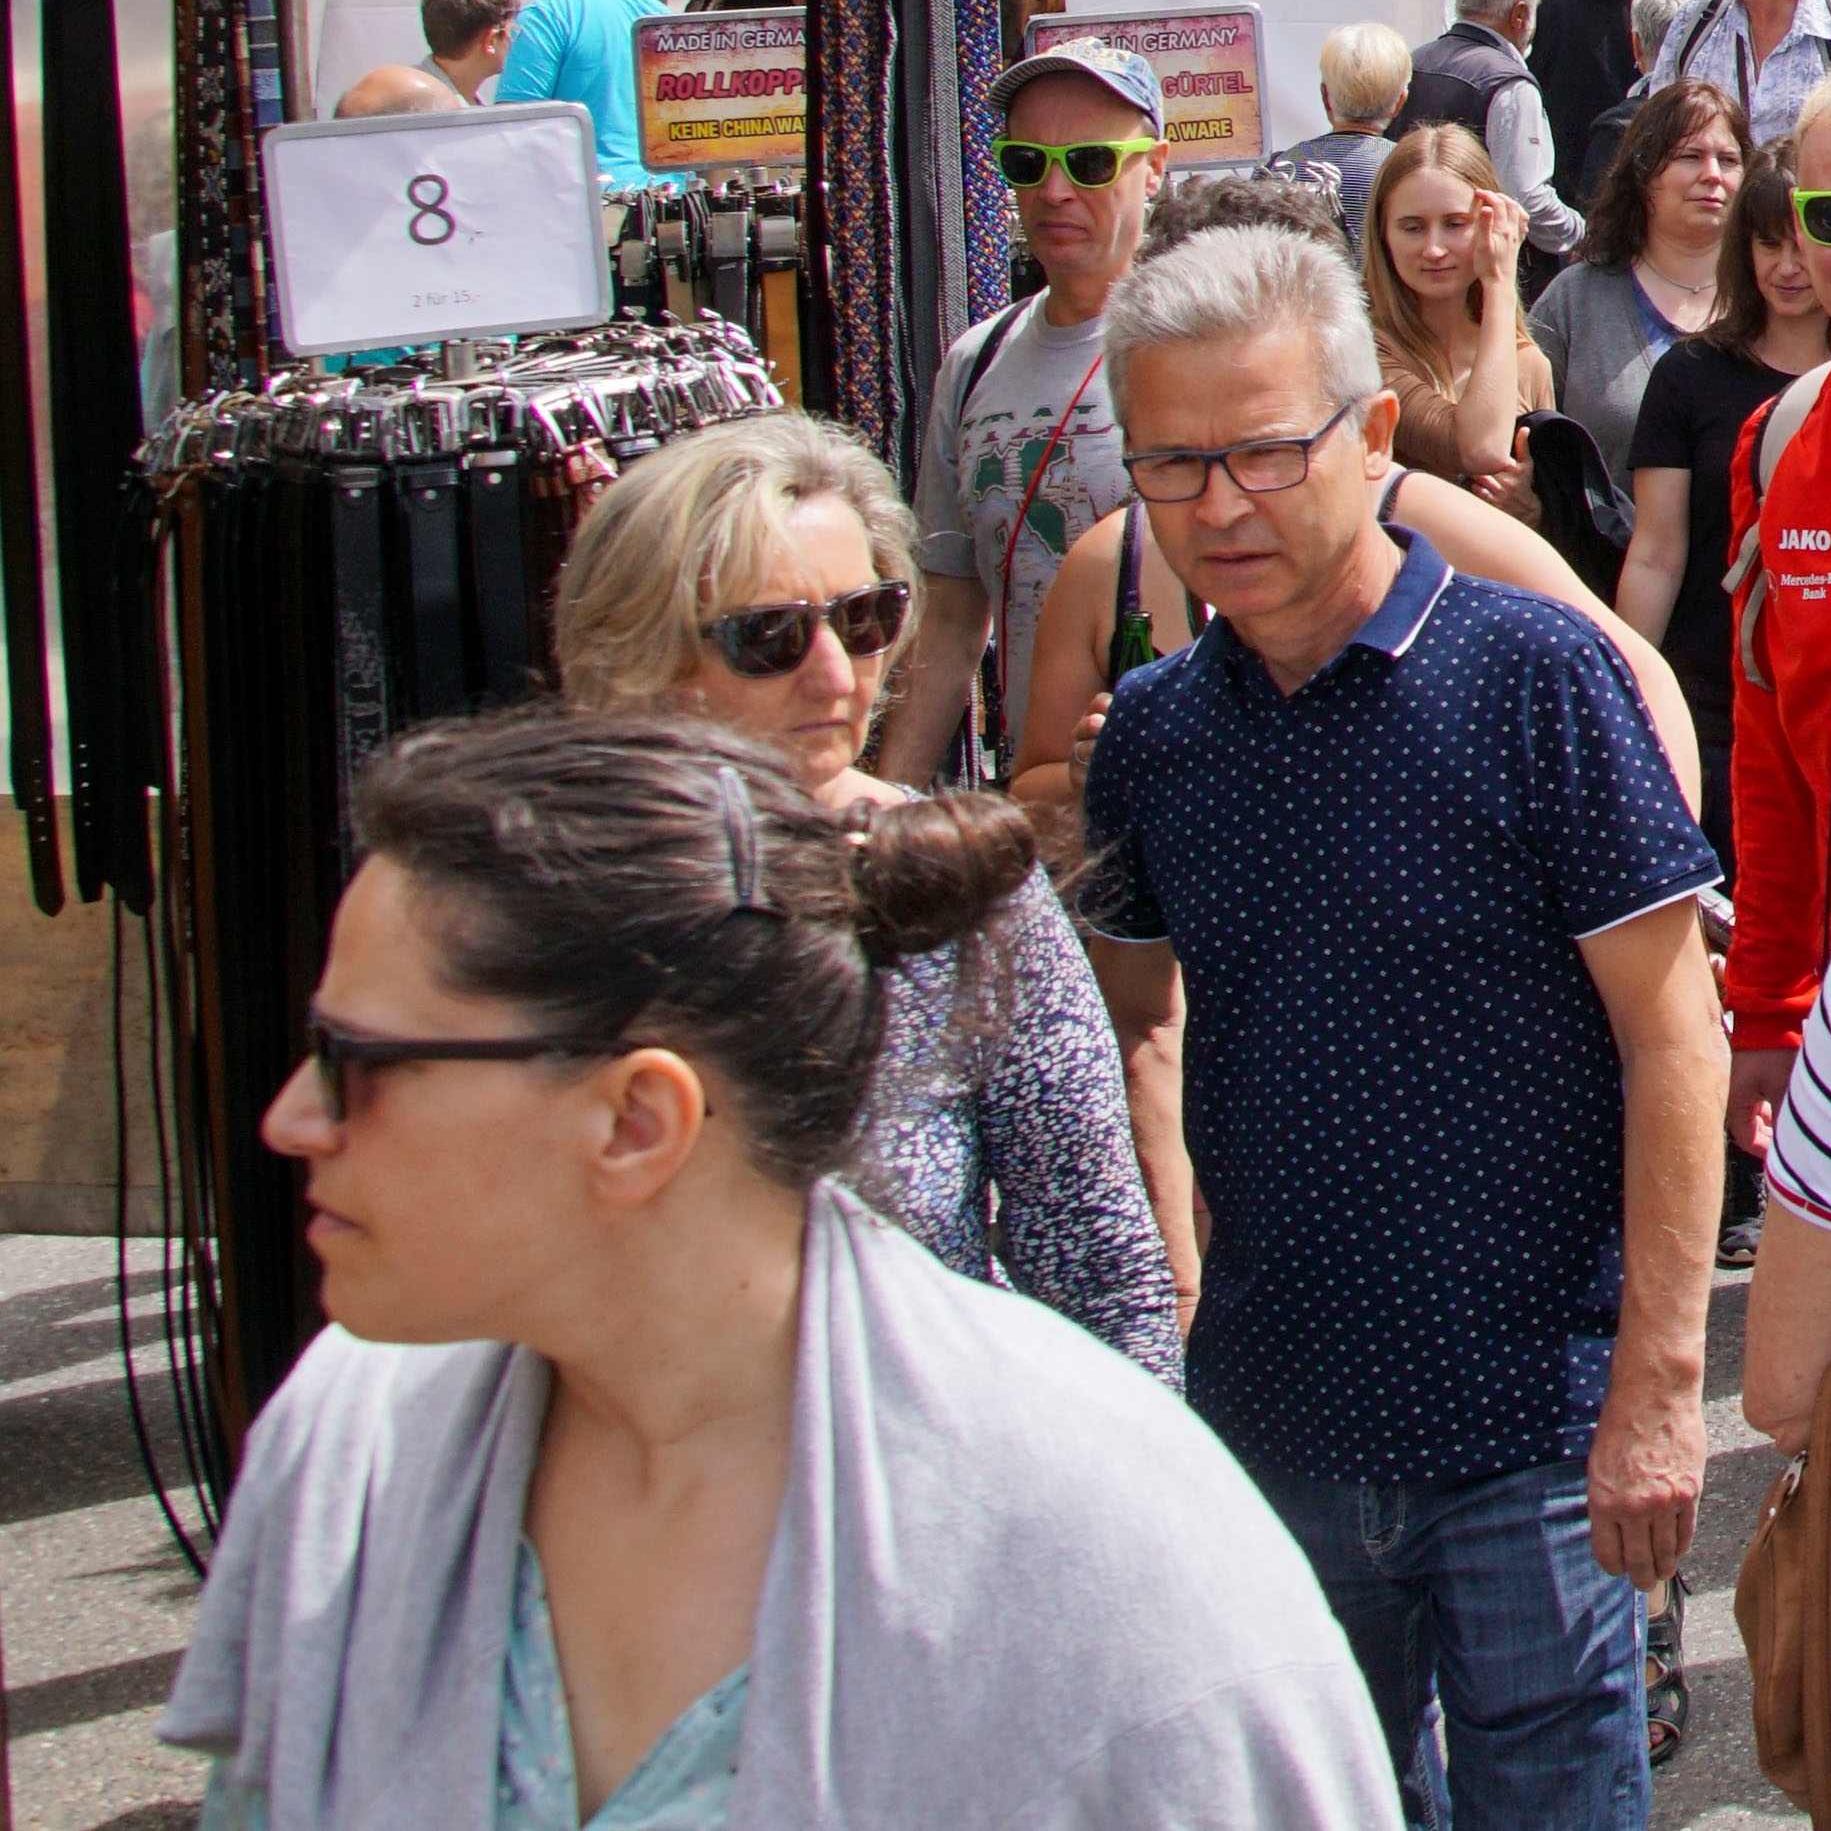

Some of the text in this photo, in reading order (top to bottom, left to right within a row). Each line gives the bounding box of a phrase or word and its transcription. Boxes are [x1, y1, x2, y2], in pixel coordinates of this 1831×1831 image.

[656, 33, 712, 54] MADE
[714, 30, 737, 50] IN
[1143, 26, 1239, 52] GERMANY
[656, 67, 807, 102] ROLLKOPP
[1161, 70, 1254, 98] GÜRTEL
[669, 120, 720, 141] KEINE
[722, 116, 774, 138] CHINA
[1180, 118, 1233, 142] WARE
[408, 173, 456, 246] 8
[413, 294, 422, 308] 2
[427, 292, 449, 306] für
[1778, 528, 1831, 551] JAKO
[1801, 586, 1827, 601] Bank
